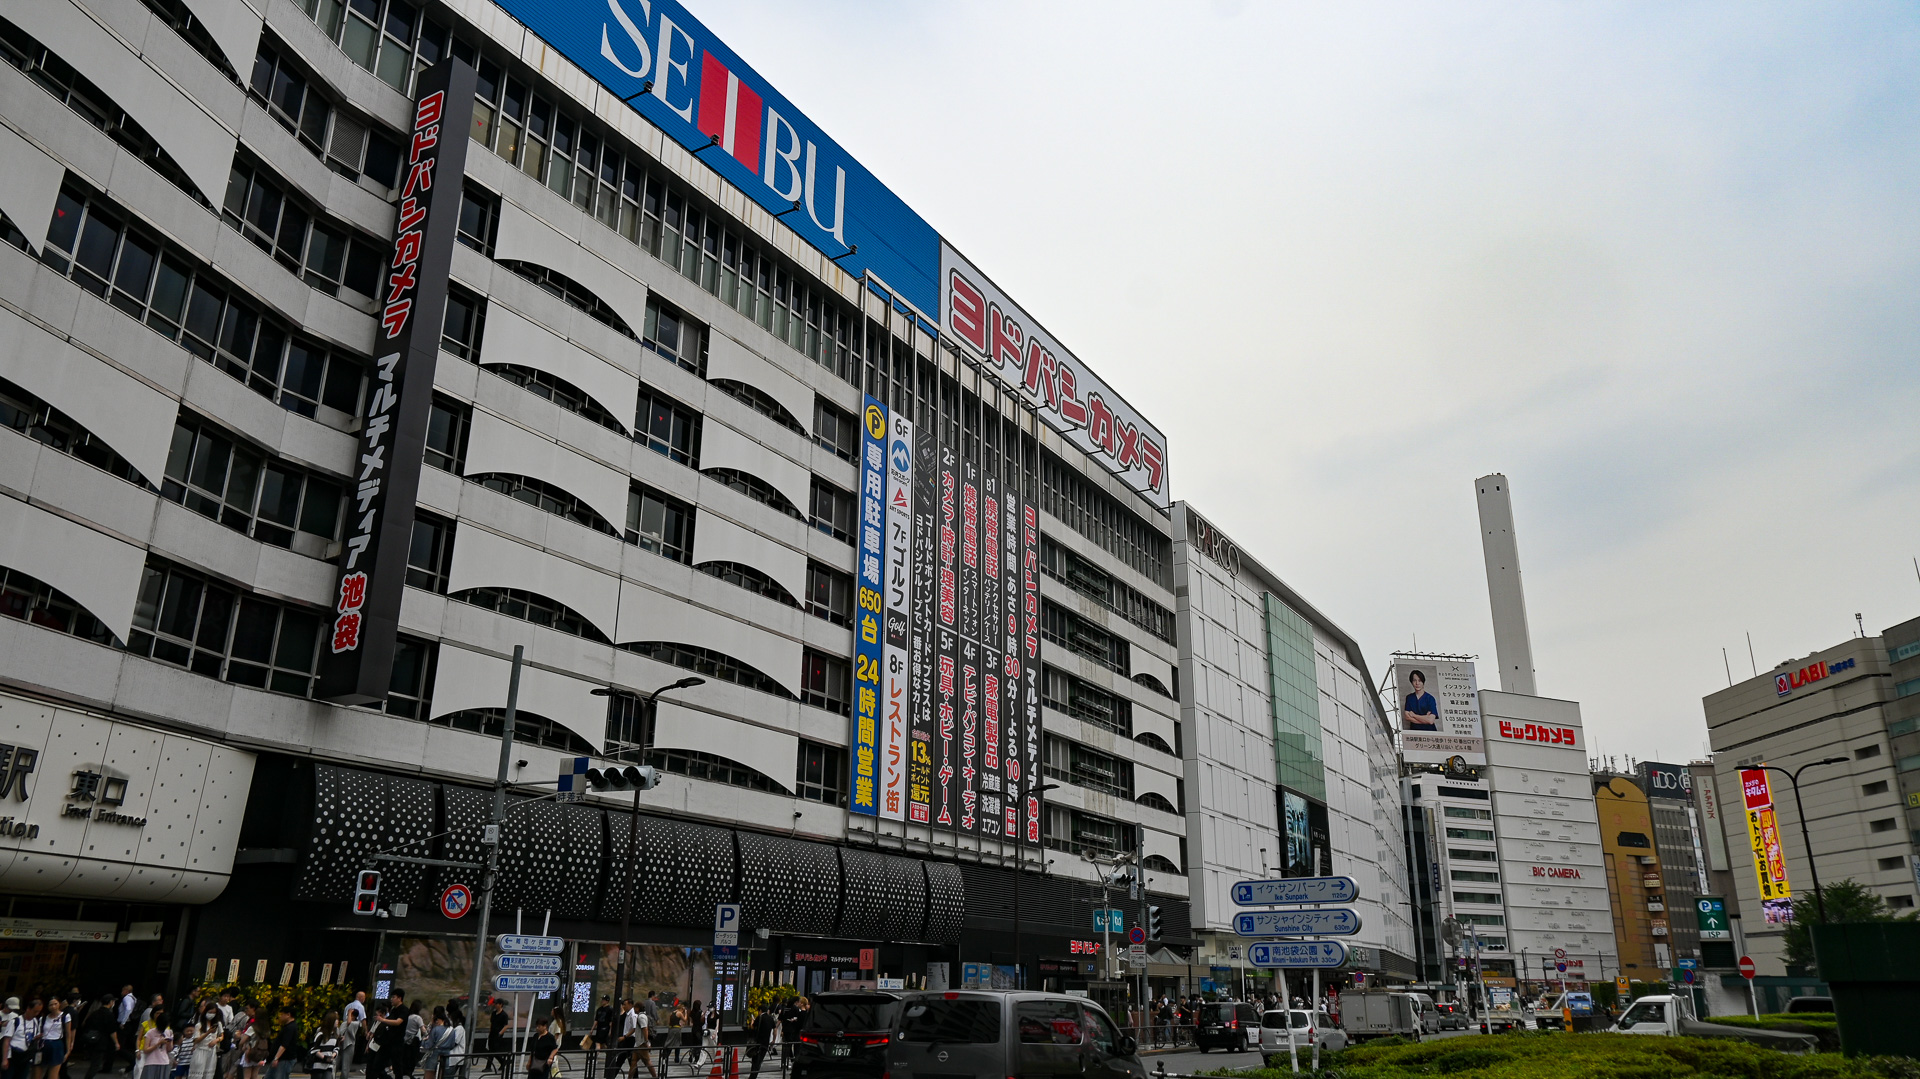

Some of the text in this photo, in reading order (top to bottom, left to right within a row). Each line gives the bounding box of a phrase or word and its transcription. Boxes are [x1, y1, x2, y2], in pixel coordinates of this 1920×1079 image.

[600, 0, 850, 250] SEIBU
[382, 90, 444, 339] ヨドバシカメラ
[949, 267, 1163, 495] ヨドバシカメラ
[894, 418, 909, 437] 6F
[332, 351, 400, 653] マルチメディア 池袋
[963, 462, 978, 568] 1F 携帯電話
[940, 447, 956, 625] 2F カメラ・時計・理美容
[985, 478, 998, 580] B1 携帯電話
[1006, 492, 1017, 574] 営業時間
[1195, 515, 1240, 577] PARCO
[892, 522, 906, 608] 7F ゴルフ
[888, 616, 906, 636] Golf
[889, 654, 903, 675] 8F
[1024, 504, 1039, 843] ヨドバシカメラ マルチメディア 池袋
[1789, 661, 1829, 689] LABI
[938, 631, 954, 826] 5F 玩具・ホビー・ゲーム
[984, 651, 999, 770] 3F 家電製品
[855, 653, 879, 807] 24時間営業
[885, 677, 902, 814] レストラン街
[961, 642, 977, 829] 4F テレビ・パソコン・オーディオ
[1498, 720, 1575, 745] ビックカメラ
[911, 740, 931, 766] 13%
[71, 769, 128, 806] 東口
[1745, 783, 1766, 798] キタムラ
[65, 803, 147, 827] East Entrance
[982, 818, 1000, 836] エアコン
[1532, 866, 1581, 879] BIC CAMERA
[1750, 811, 1772, 897] おトクにお買物
[1256, 881, 1326, 894] イケ・サンパーク
[1285, 893, 1308, 902] Sunpark
[720, 907, 735, 929] P
[1256, 914, 1330, 925] サンシャインシティ
[1274, 924, 1300, 932] Sunshine
[1301, 923, 1313, 933] City
[1272, 946, 1318, 956] 南池袋公園
[1272, 956, 1308, 964] Minami-Ikebukuro
